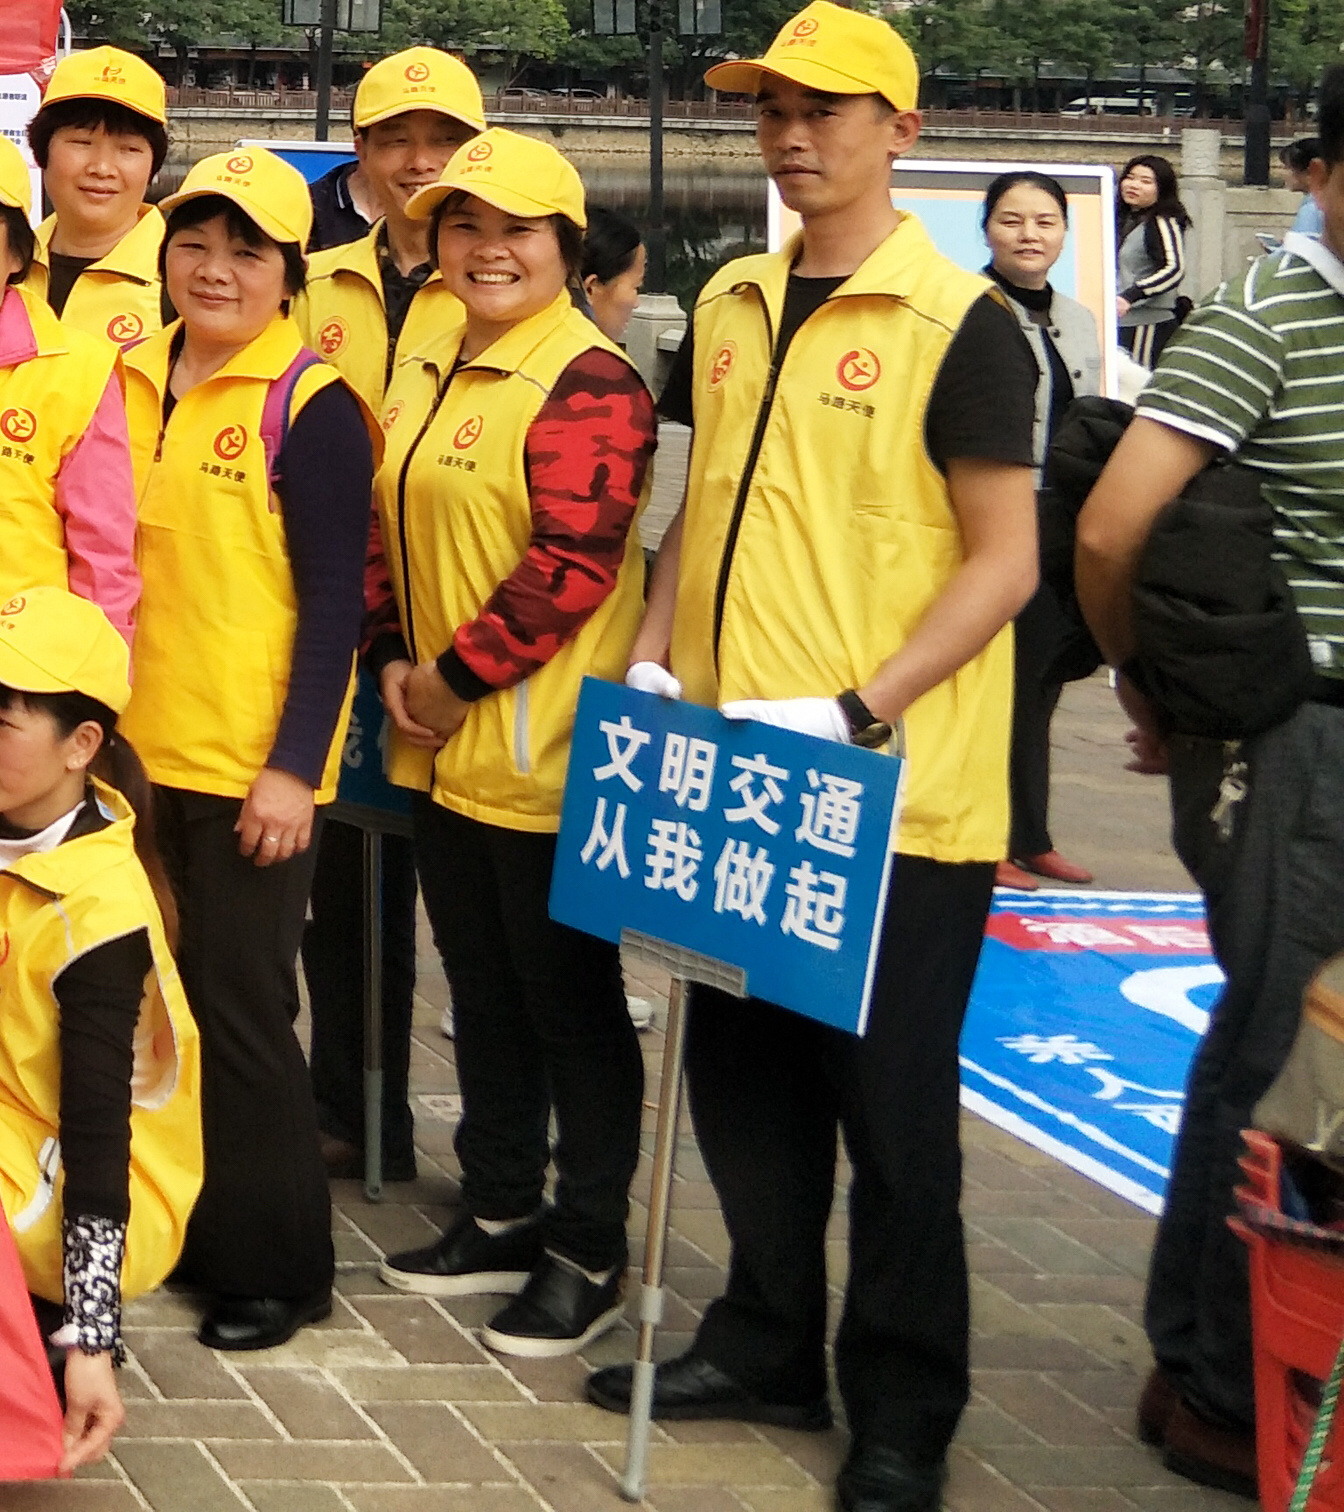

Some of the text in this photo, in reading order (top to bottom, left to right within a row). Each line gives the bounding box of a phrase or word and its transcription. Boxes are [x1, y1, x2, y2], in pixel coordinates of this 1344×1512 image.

[816, 390, 876, 419] 马路天使
[198, 461, 248, 485] 马路天使
[592, 714, 866, 859] 文明交通
[579, 796, 849, 953] 从我做起
